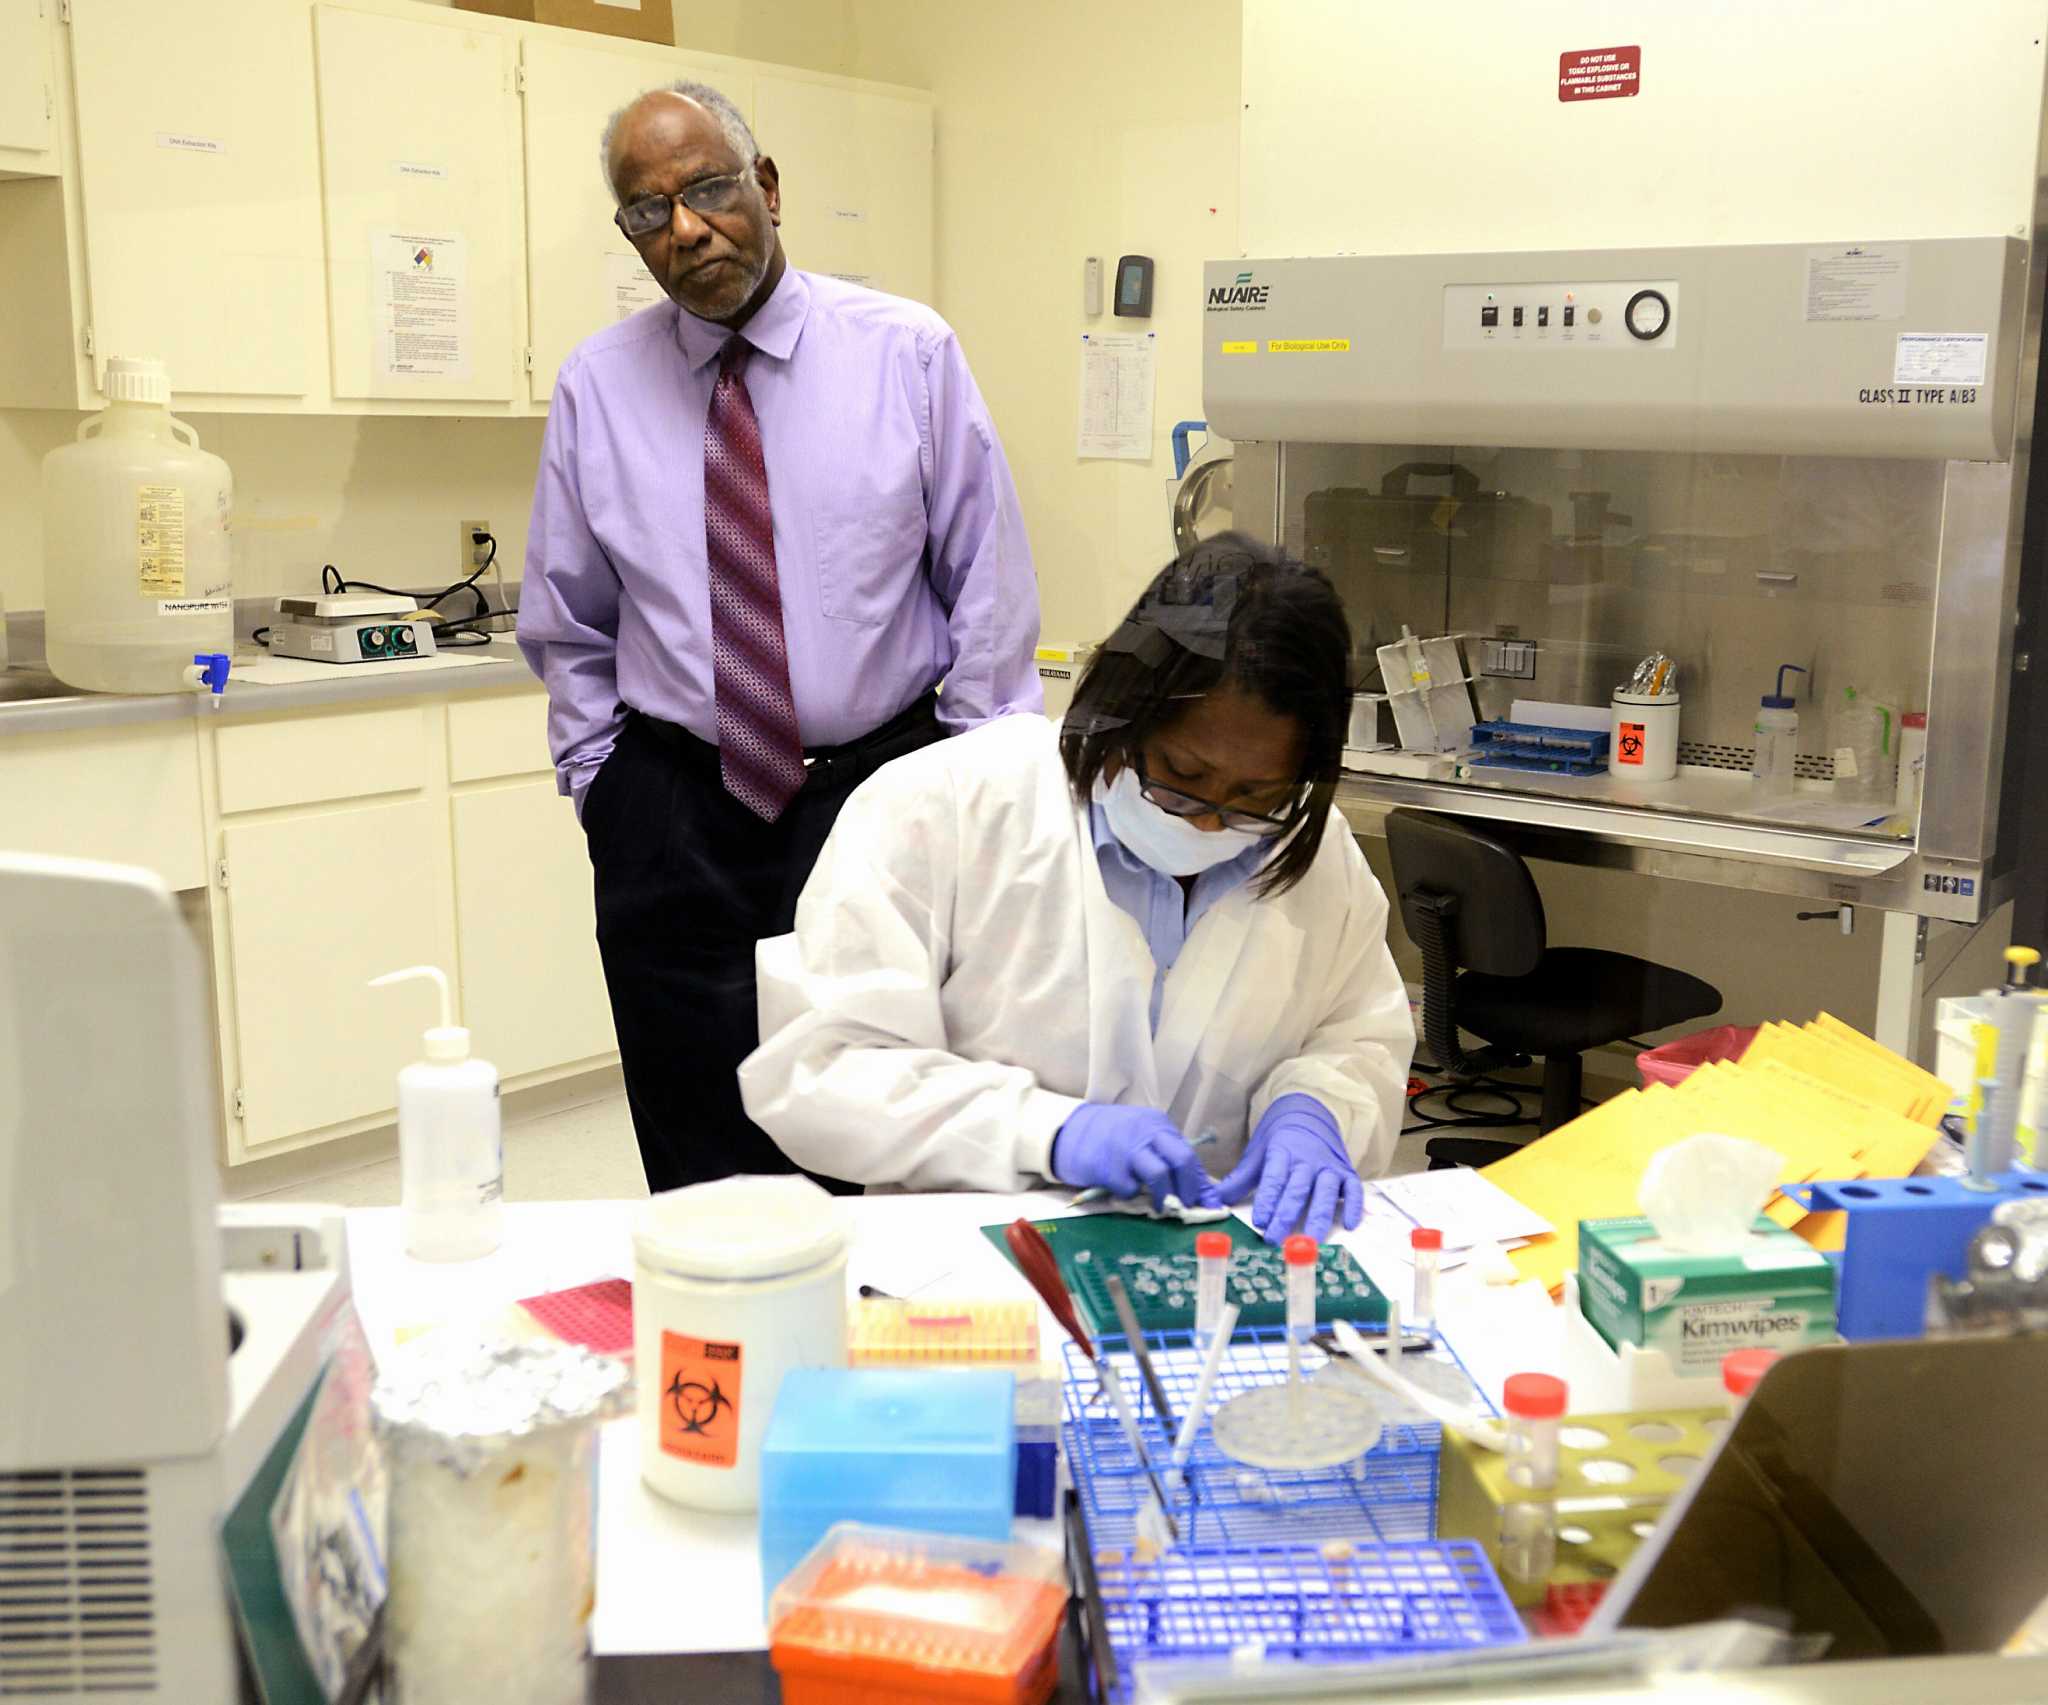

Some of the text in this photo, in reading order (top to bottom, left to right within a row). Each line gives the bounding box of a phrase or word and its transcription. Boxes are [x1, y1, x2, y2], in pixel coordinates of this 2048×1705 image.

[1580, 54, 1616, 64] DO NOT USE
[1587, 64, 1619, 74] EXPLOSIVE
[1597, 72, 1637, 83] SUBSTANCES
[1208, 286, 1269, 304] NUAIRE
[1271, 341, 1347, 351] For Biological Use Only
[1859, 388, 1895, 404] CLASS
[1916, 389, 1945, 404] TYPE
[1949, 388, 1976, 404] A/B3
[1683, 1303, 1742, 1317] KIMTECH
[1682, 1311, 1800, 1338] Kimwipes
